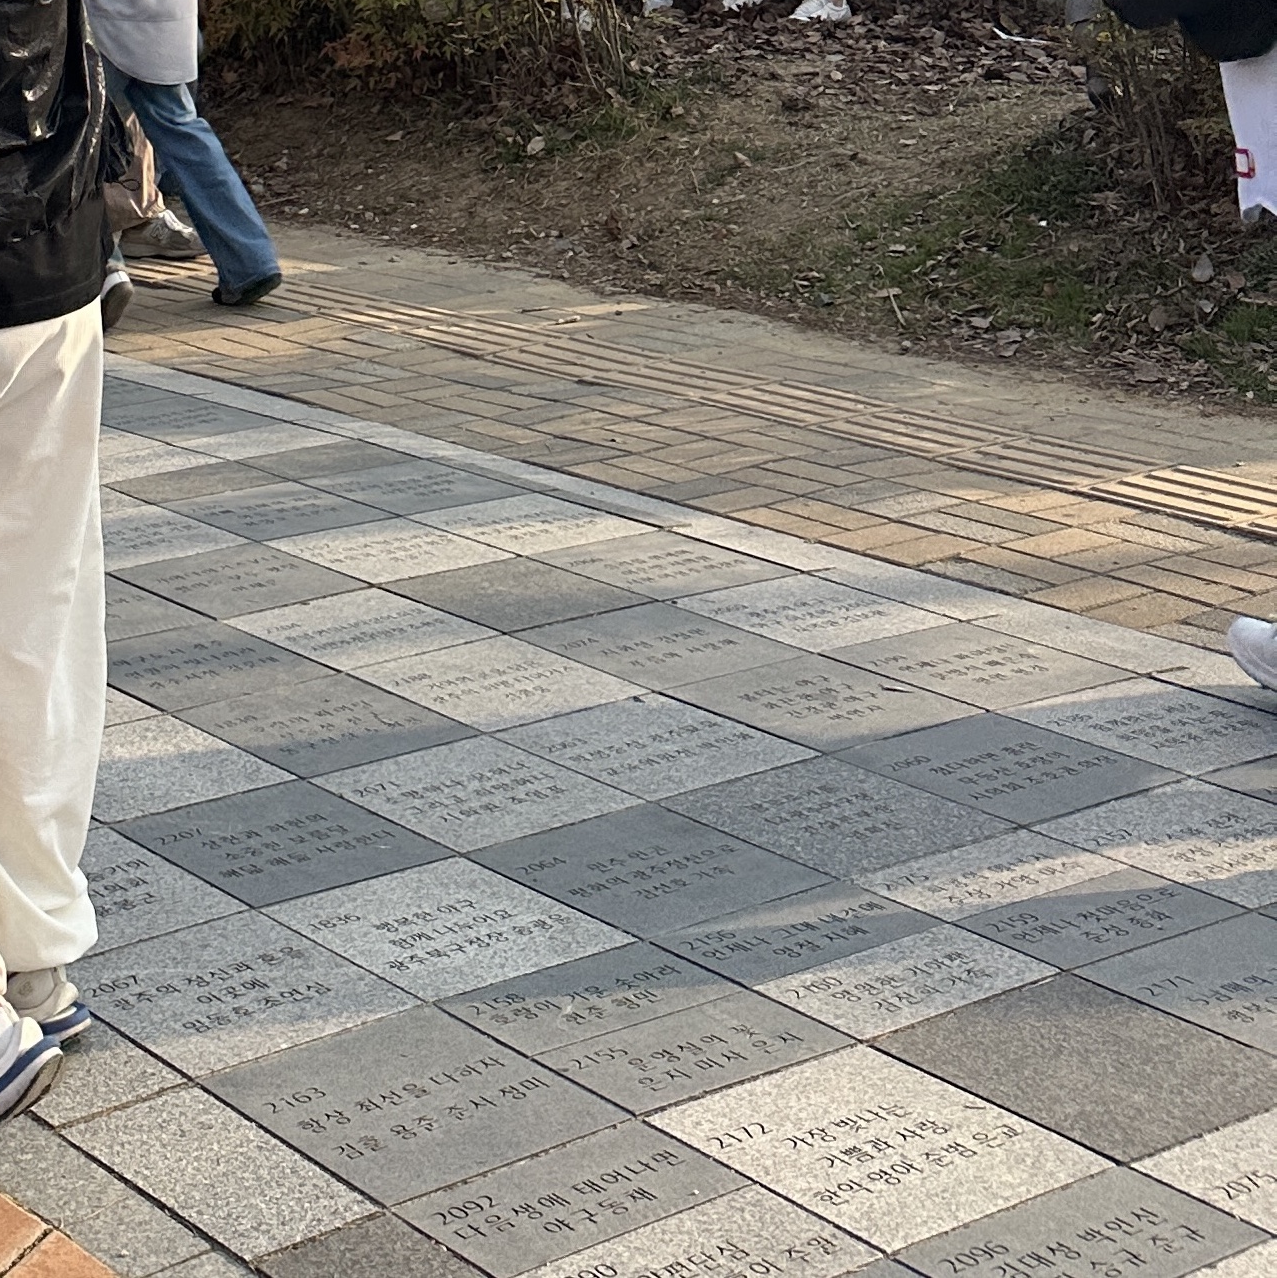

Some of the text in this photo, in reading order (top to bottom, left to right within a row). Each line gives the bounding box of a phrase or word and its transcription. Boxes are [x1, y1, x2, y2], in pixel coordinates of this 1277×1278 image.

[887, 755, 931, 772] 2060
[352, 780, 400, 797] 2071
[516, 856, 566, 875] 2064
[692, 866, 734, 879] 가족
[308, 914, 361, 930] 1836
[372, 899, 477, 932] 행복한 야구
[985, 912, 1039, 932] 2159
[1011, 887, 1179, 943] 언제나 첫마음으로
[388, 931, 435, 949] 함께
[680, 929, 736, 950] 2156
[701, 935, 771, 960] 언제나
[771, 921, 820, 938] 그대
[80, 974, 139, 998] 2067
[113, 983, 181, 1010] 광주의
[183, 961, 254, 987] 정신과
[830, 975, 904, 1002] 영원한
[940, 967, 992, 986] 가족
[1142, 975, 1193, 996] 2171
[196, 978, 269, 1003] 이곳에
[490, 964, 681, 1024] 호랑이 기운 솟아라
[469, 992, 525, 1015] 2158
[728, 1023, 760, 1037] 꽃
[571, 1047, 628, 1069] 2155
[265, 1087, 326, 1113] 2163
[298, 1056, 505, 1133] 항상 최선을 다하자
[710, 1122, 767, 1149] 2172
[784, 1104, 911, 1149] 가장 빛나는
[817, 1119, 948, 1168] 기쁨과 사랑
[571, 1150, 678, 1194] 태어나면
[866, 1160, 922, 1185] 영아
[1215, 1172, 1277, 1200] 2075
[434, 1195, 494, 1225] 2092
[943, 1240, 1009, 1271] 2096
